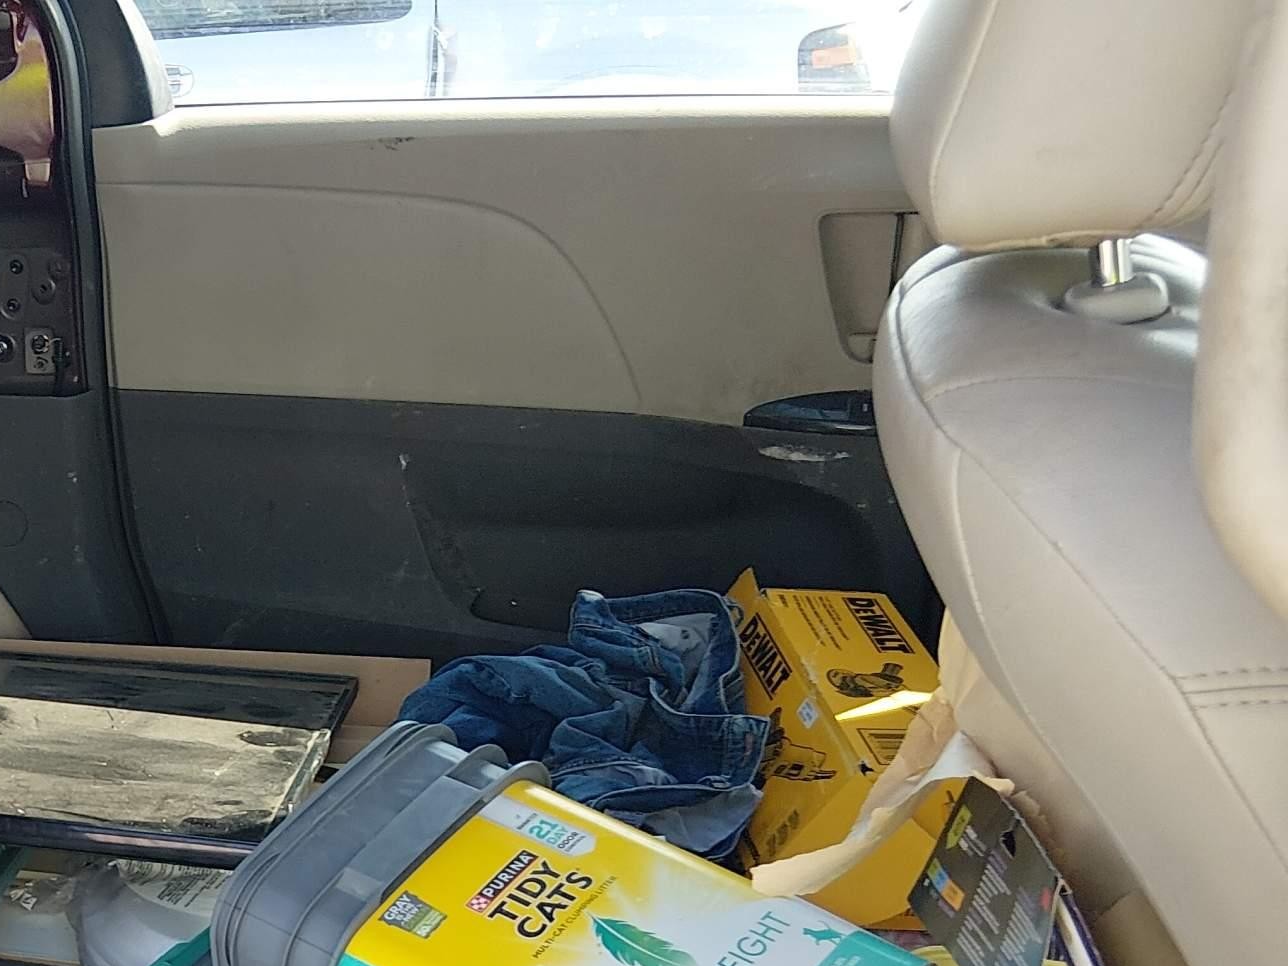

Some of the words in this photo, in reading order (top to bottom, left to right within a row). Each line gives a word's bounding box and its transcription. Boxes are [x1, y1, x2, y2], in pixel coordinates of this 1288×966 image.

[848, 597, 908, 654] DEWALT
[739, 615, 791, 694] DEWALT
[529, 819, 560, 840] 21
[546, 827, 570, 846] DAY
[558, 831, 579, 849] ODOR
[481, 852, 535, 898] PURINA
[488, 860, 561, 921] TIDY
[384, 894, 411, 921] GRAY
[516, 871, 594, 938] CATS
[532, 923, 569, 959] MULTI-CAT
[565, 892, 599, 926] CLUMPING
